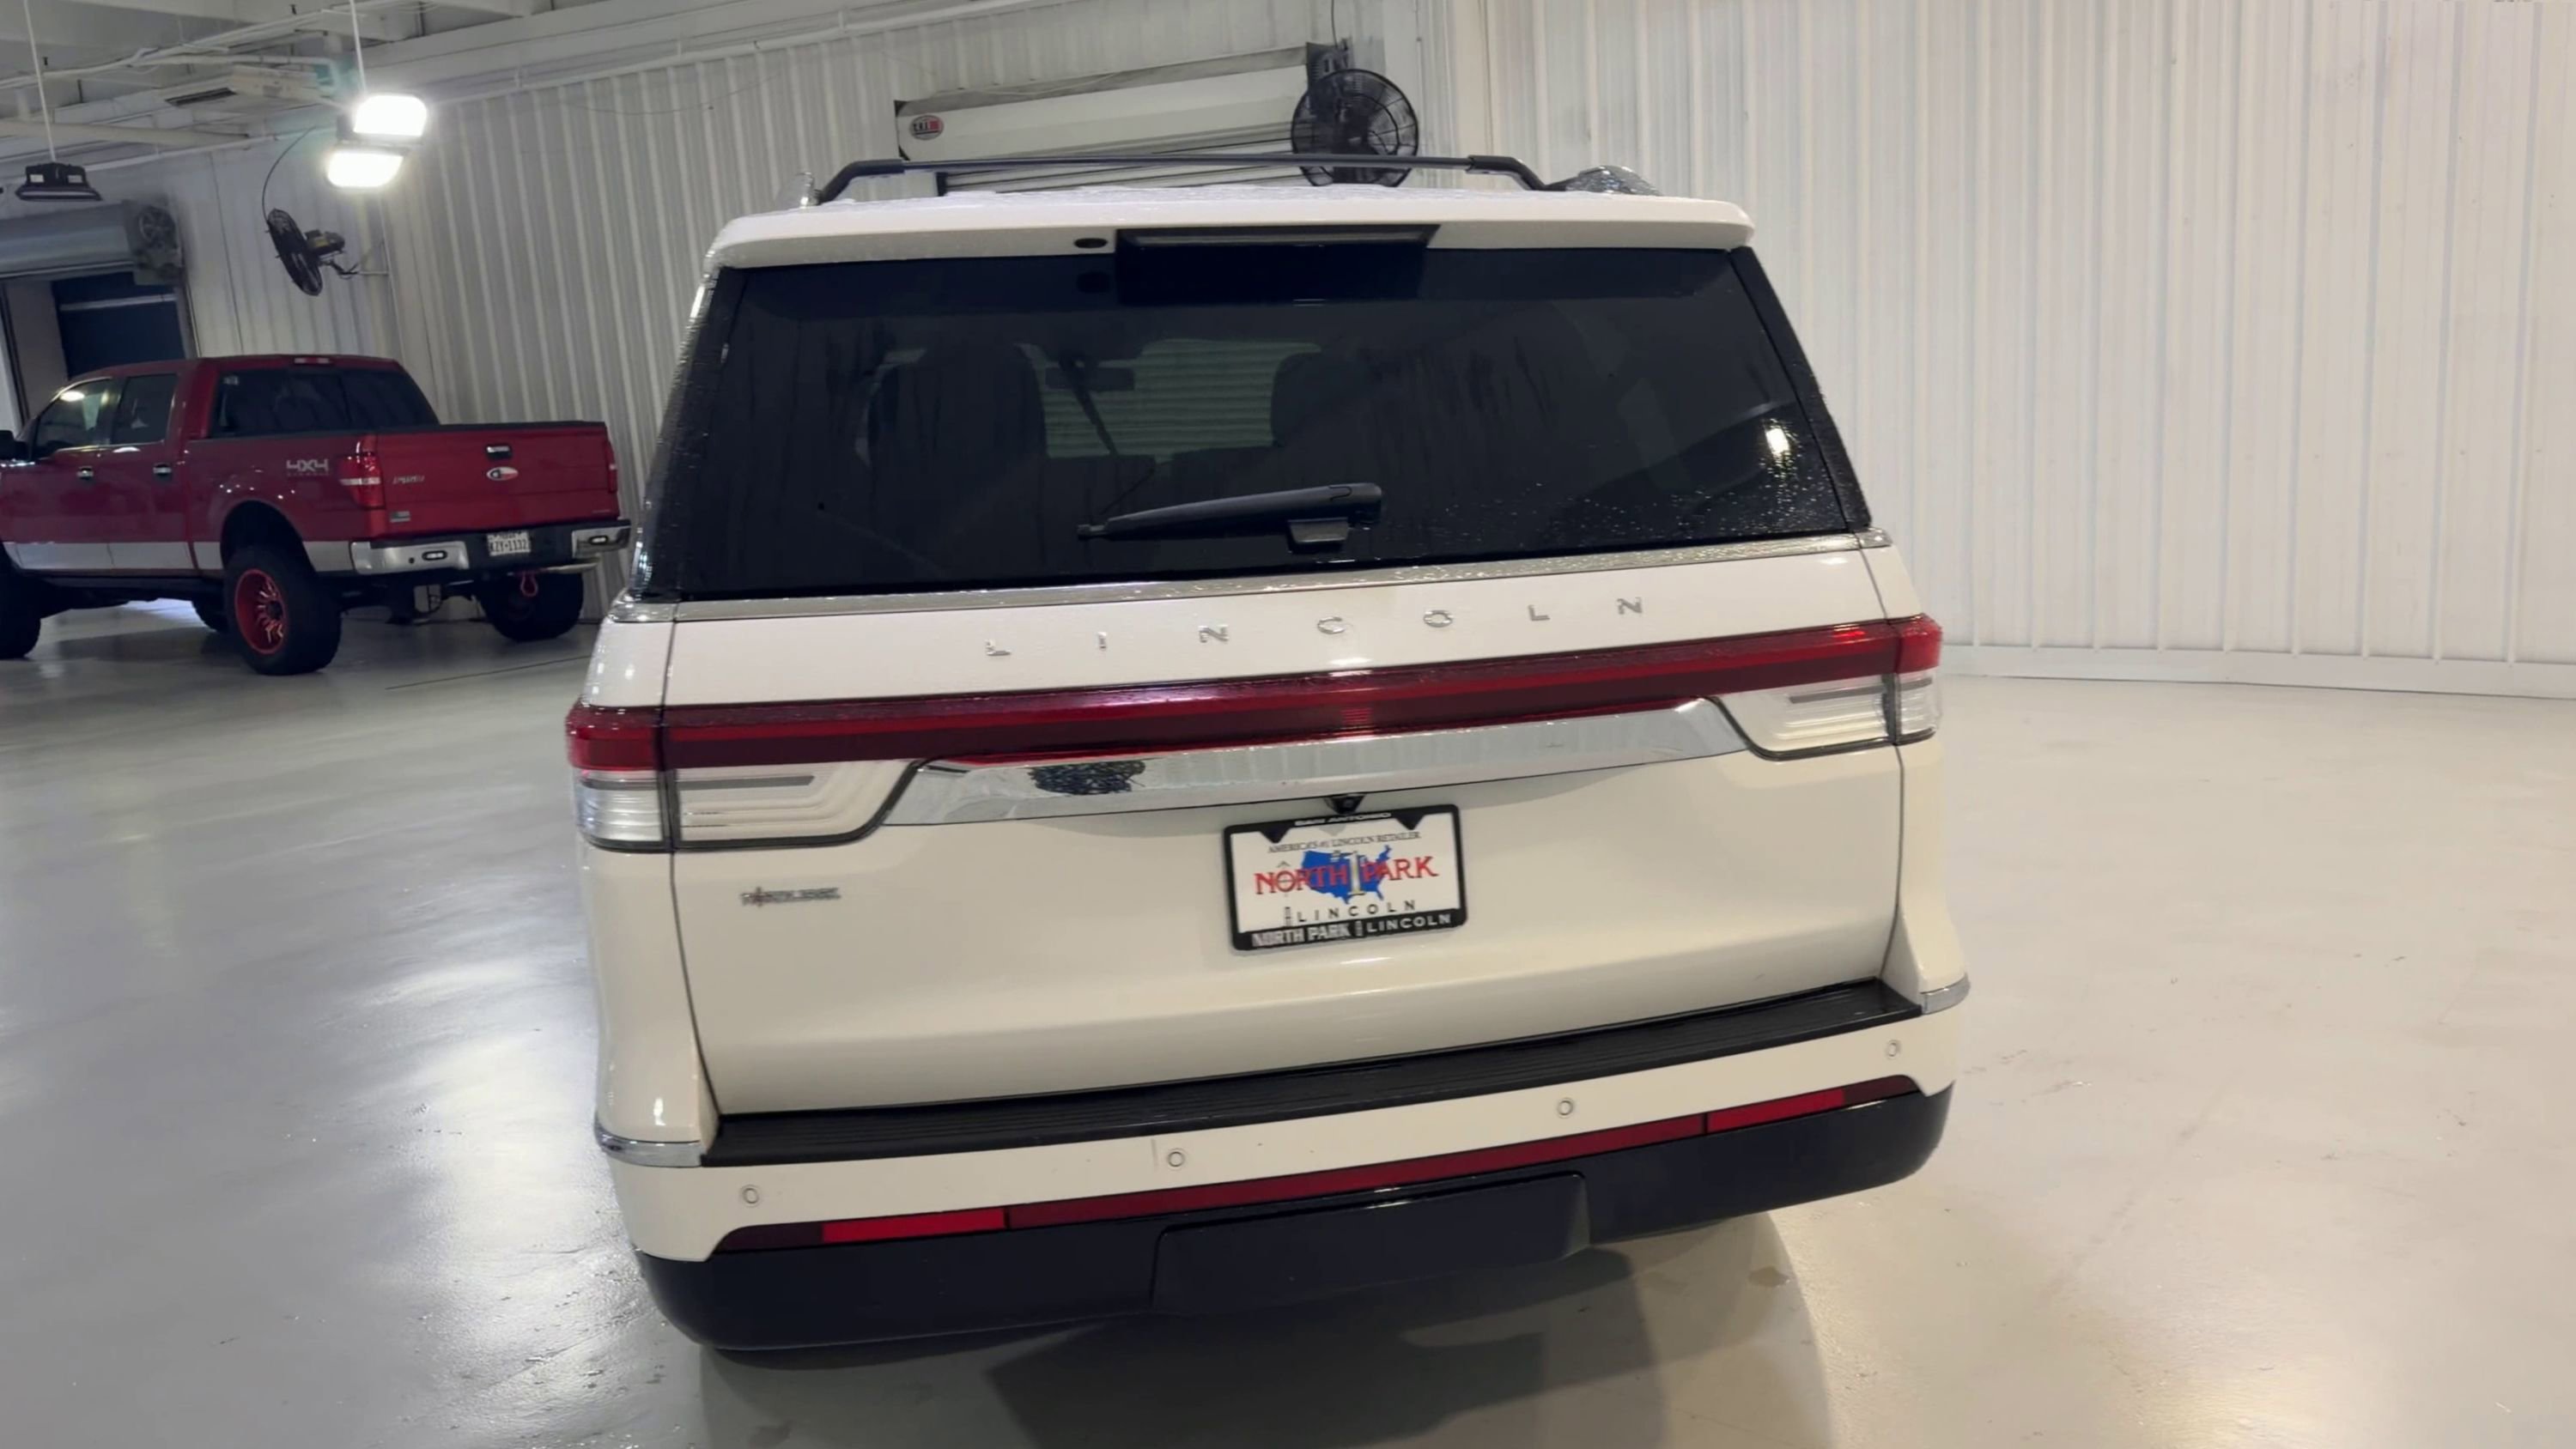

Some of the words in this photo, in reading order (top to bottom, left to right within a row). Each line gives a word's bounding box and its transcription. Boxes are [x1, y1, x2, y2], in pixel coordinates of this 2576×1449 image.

[985, 595, 1643, 657] LINCOLN
[1331, 834, 1375, 847] LINCOLN
[1254, 862, 1348, 894] NORTH
[1360, 856, 1440, 882] PARK
[1297, 900, 1417, 923] LINCOLN
[1252, 927, 1305, 948] NORTH
[1307, 922, 1352, 942] PARK
[1366, 913, 1452, 934] LINCOLN
